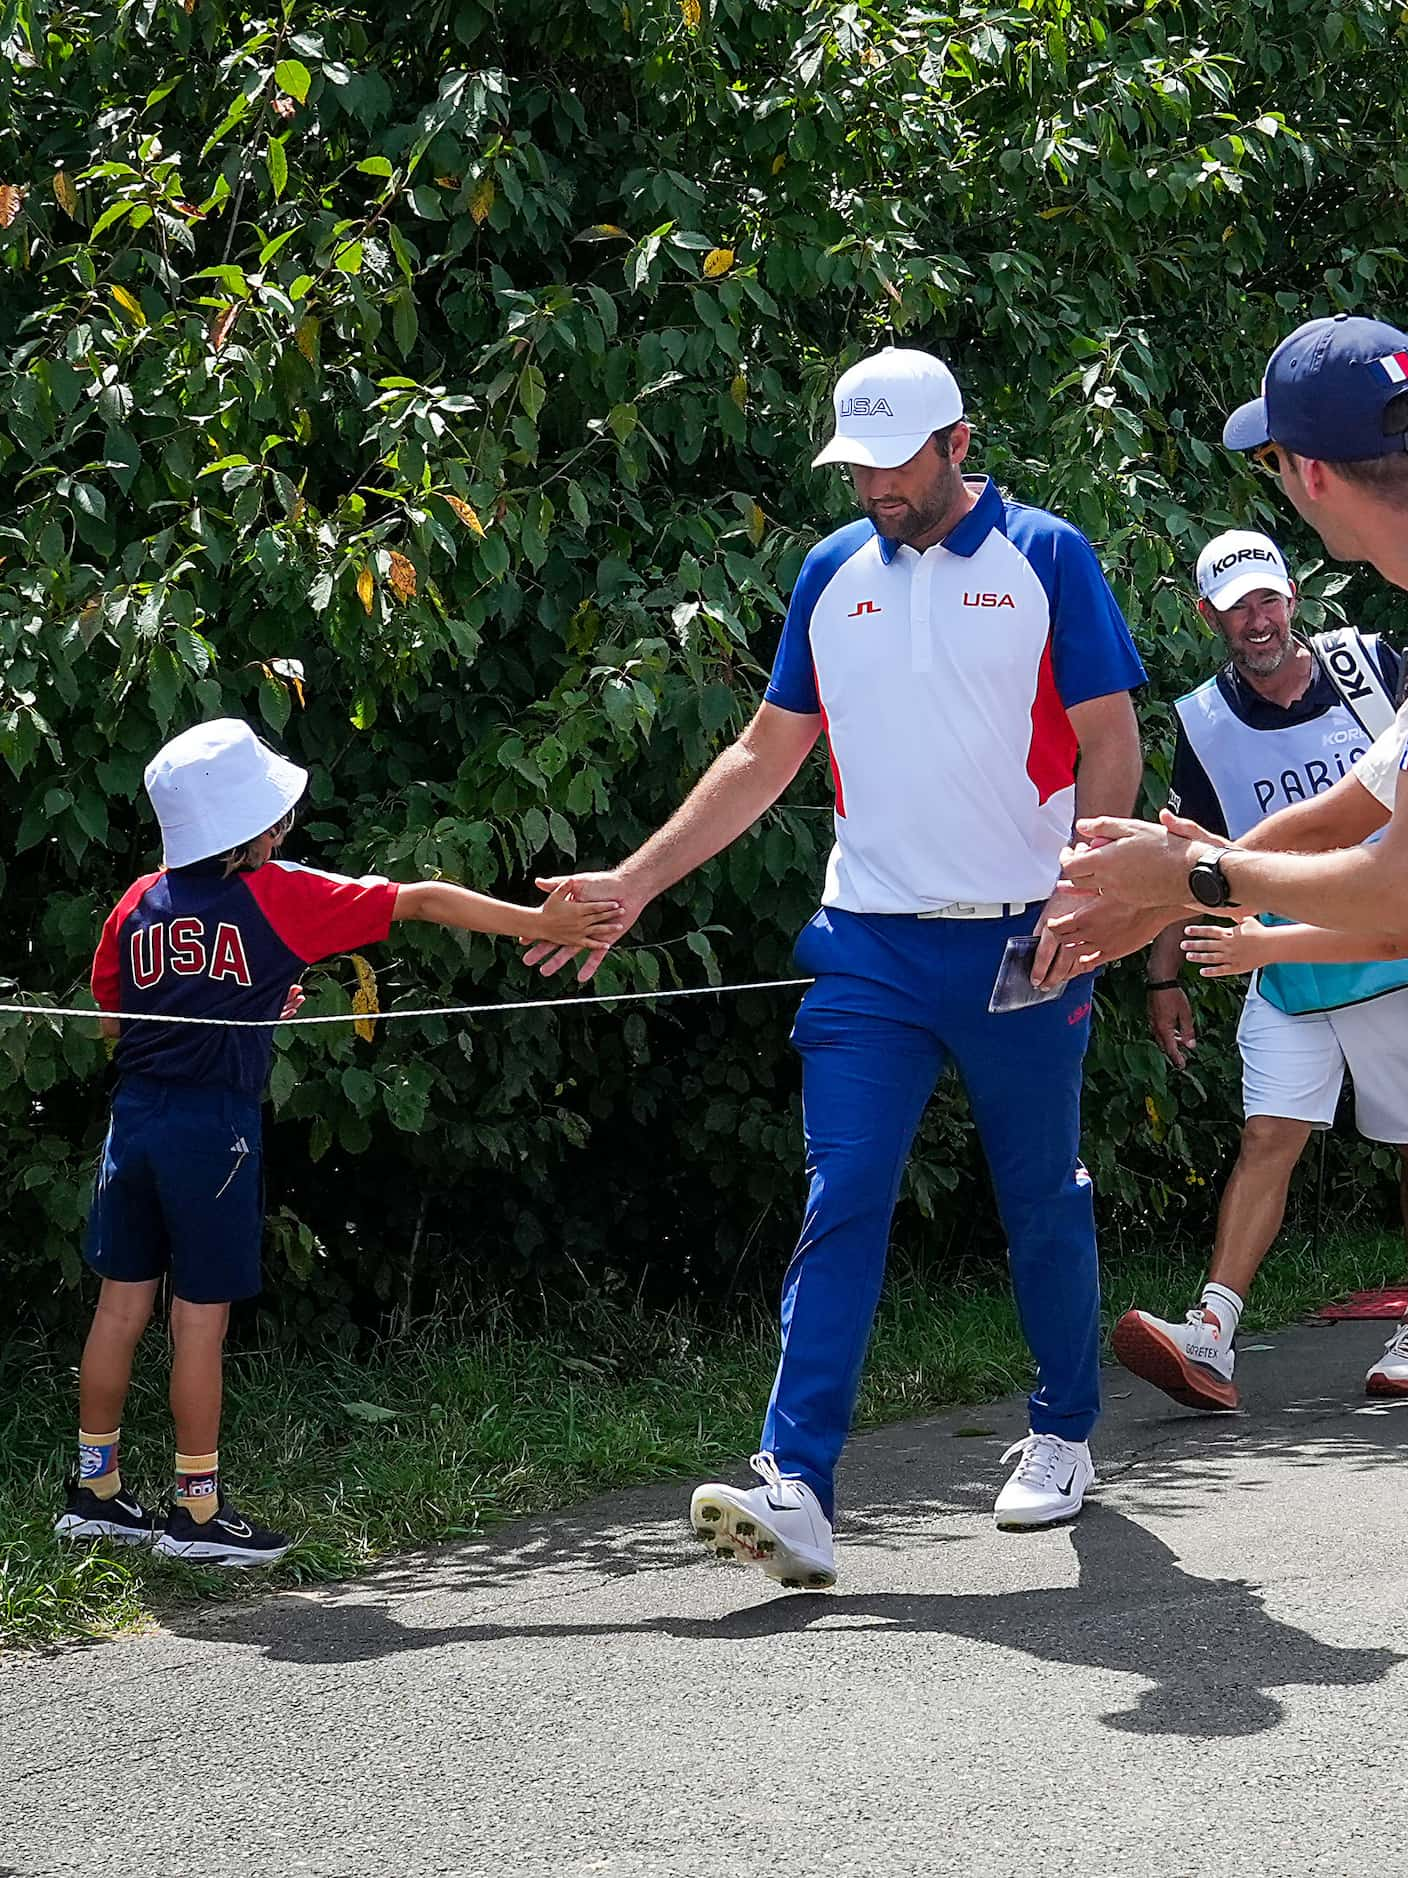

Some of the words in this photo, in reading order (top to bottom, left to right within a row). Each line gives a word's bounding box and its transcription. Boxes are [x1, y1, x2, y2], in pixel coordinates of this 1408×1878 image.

[841, 397, 894, 417] USA
[962, 592, 1016, 609] USA
[131, 917, 252, 989] USA
